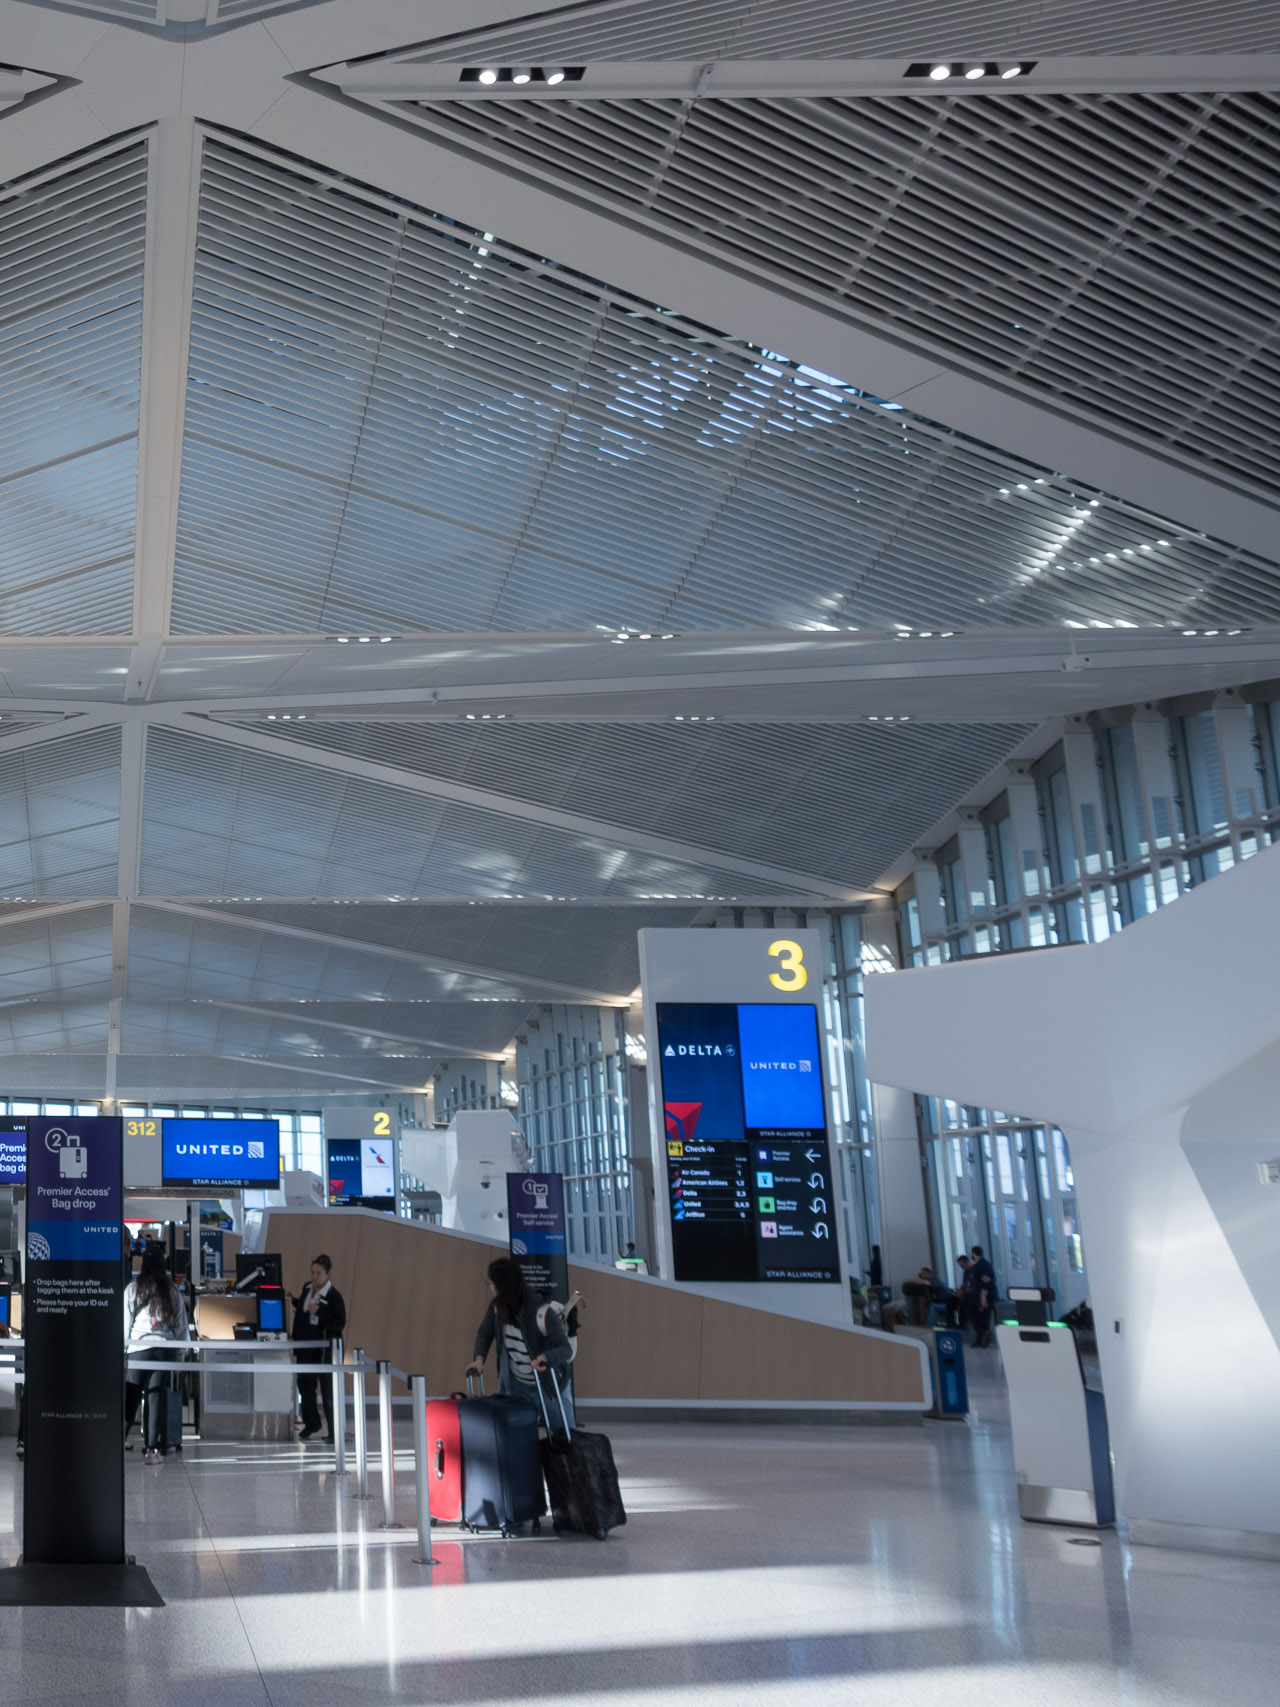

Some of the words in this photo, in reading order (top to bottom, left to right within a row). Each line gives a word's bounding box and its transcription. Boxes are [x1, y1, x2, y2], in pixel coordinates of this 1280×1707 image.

[768, 940, 808, 992] 3
[678, 1045, 722, 1056] DELTA
[750, 1062, 797, 1070] UNITED
[128, 1121, 156, 1136] 312
[373, 1111, 391, 1135] 2
[52, 1133, 61, 1147] 2
[0, 1143, 26, 1152] Premi
[176, 1144, 244, 1155] UNITED
[684, 1145, 715, 1153] Check-in
[0, 1154, 27, 1162] Acces
[0, 1163, 17, 1174] bag
[18, 1163, 26, 1172] dr
[37, 1186, 72, 1197] Premier
[52, 1198, 70, 1211] Bag
[72, 1198, 96, 1210] drop
[787, 1271, 823, 1279] ALLIANCE
[36, 1278, 52, 1287] Drop
[52, 1279, 68, 1287] bags
[37, 1287, 61, 1295] tagging
[36, 1298, 57, 1306] Please
[74, 1300, 89, 1308] your
